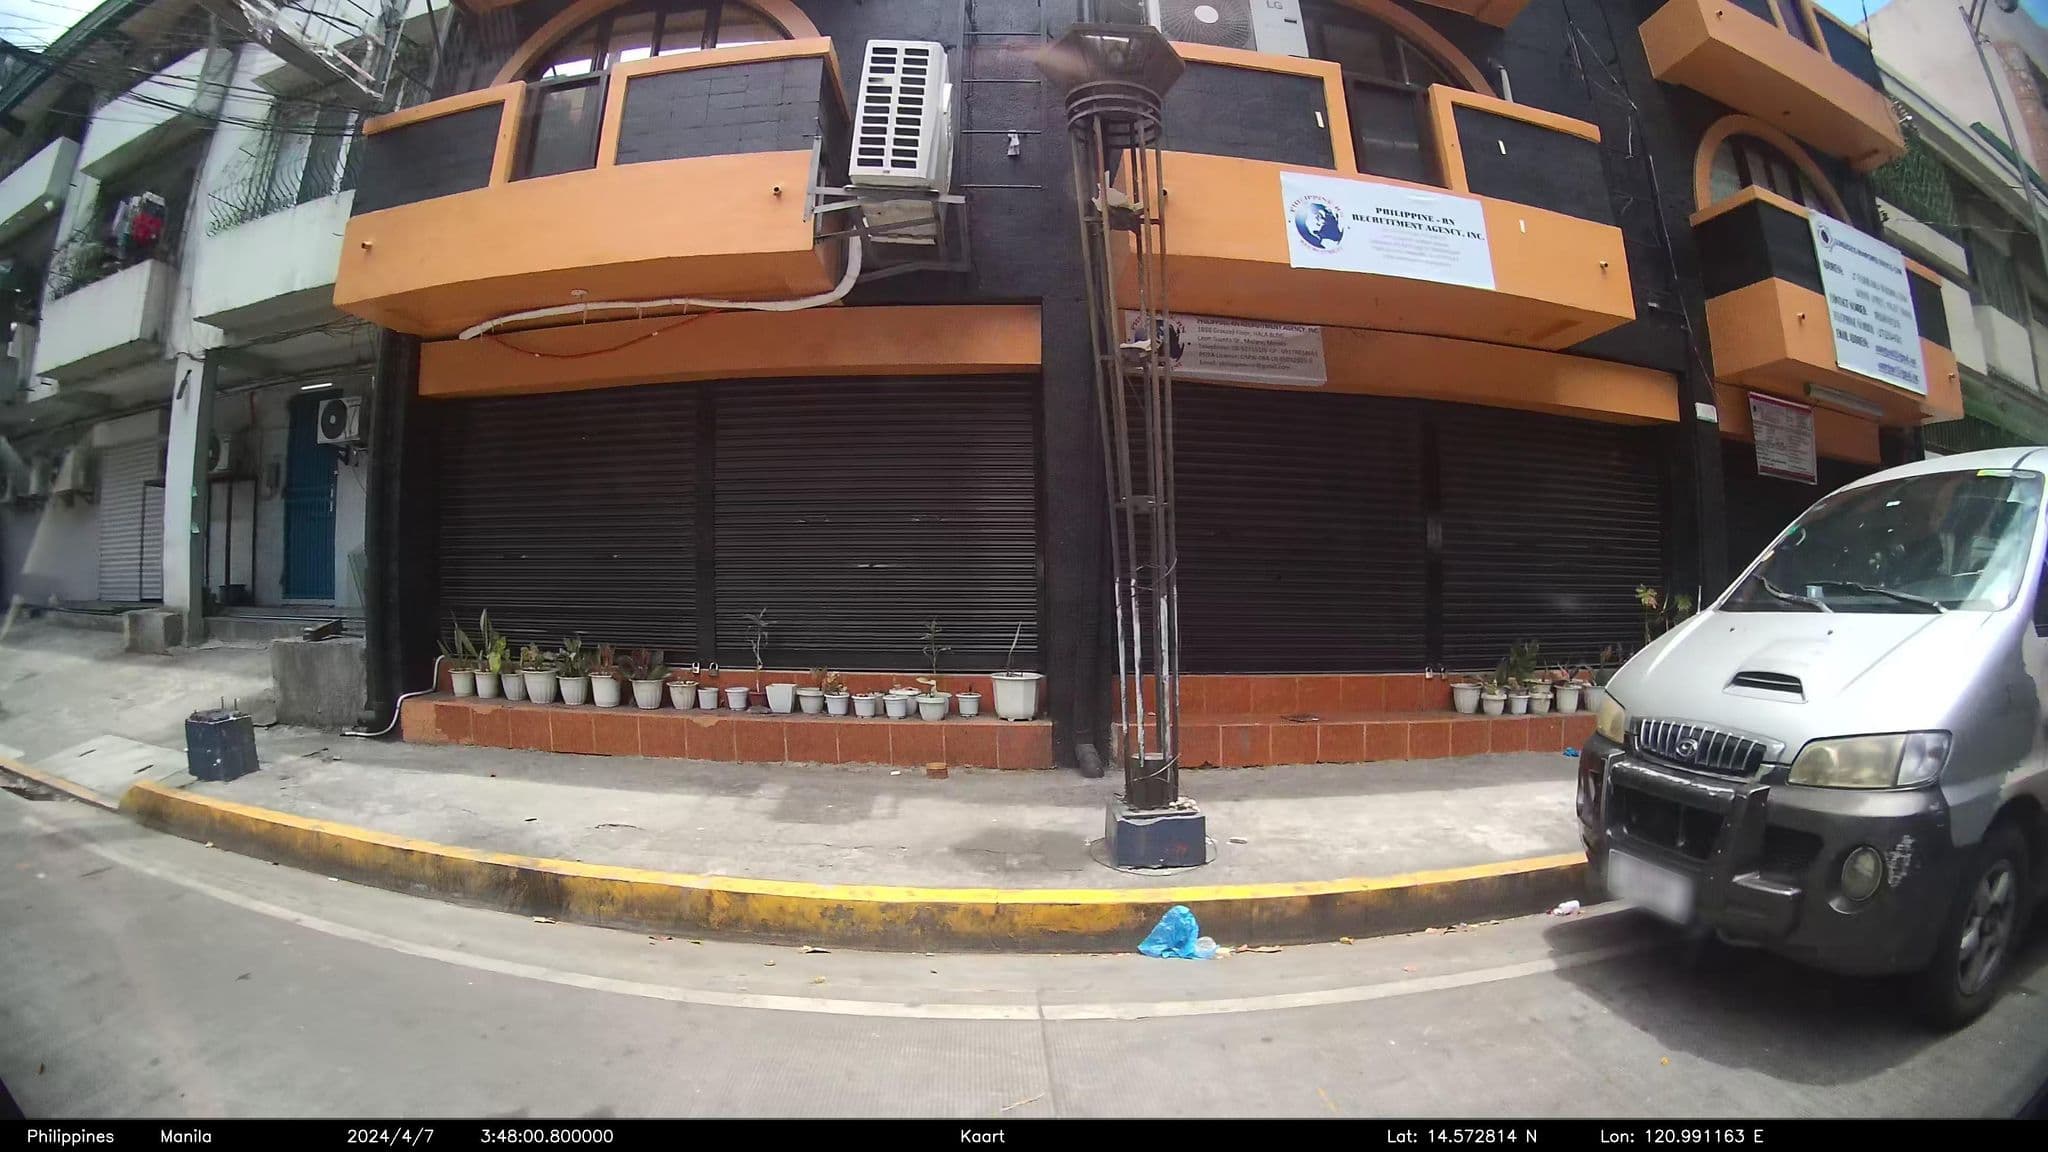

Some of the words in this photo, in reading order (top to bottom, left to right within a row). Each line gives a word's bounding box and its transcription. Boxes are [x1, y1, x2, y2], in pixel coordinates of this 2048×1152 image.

[1266, 0, 1283, 9] LG
[1375, 207, 1434, 222] PHILIPPINE
[1442, 217, 1455, 226] RN
[1352, 213, 1423, 230] RECRUITMENT
[1426, 223, 1465, 238] AGENCY,
[1466, 231, 1485, 241] INC.
